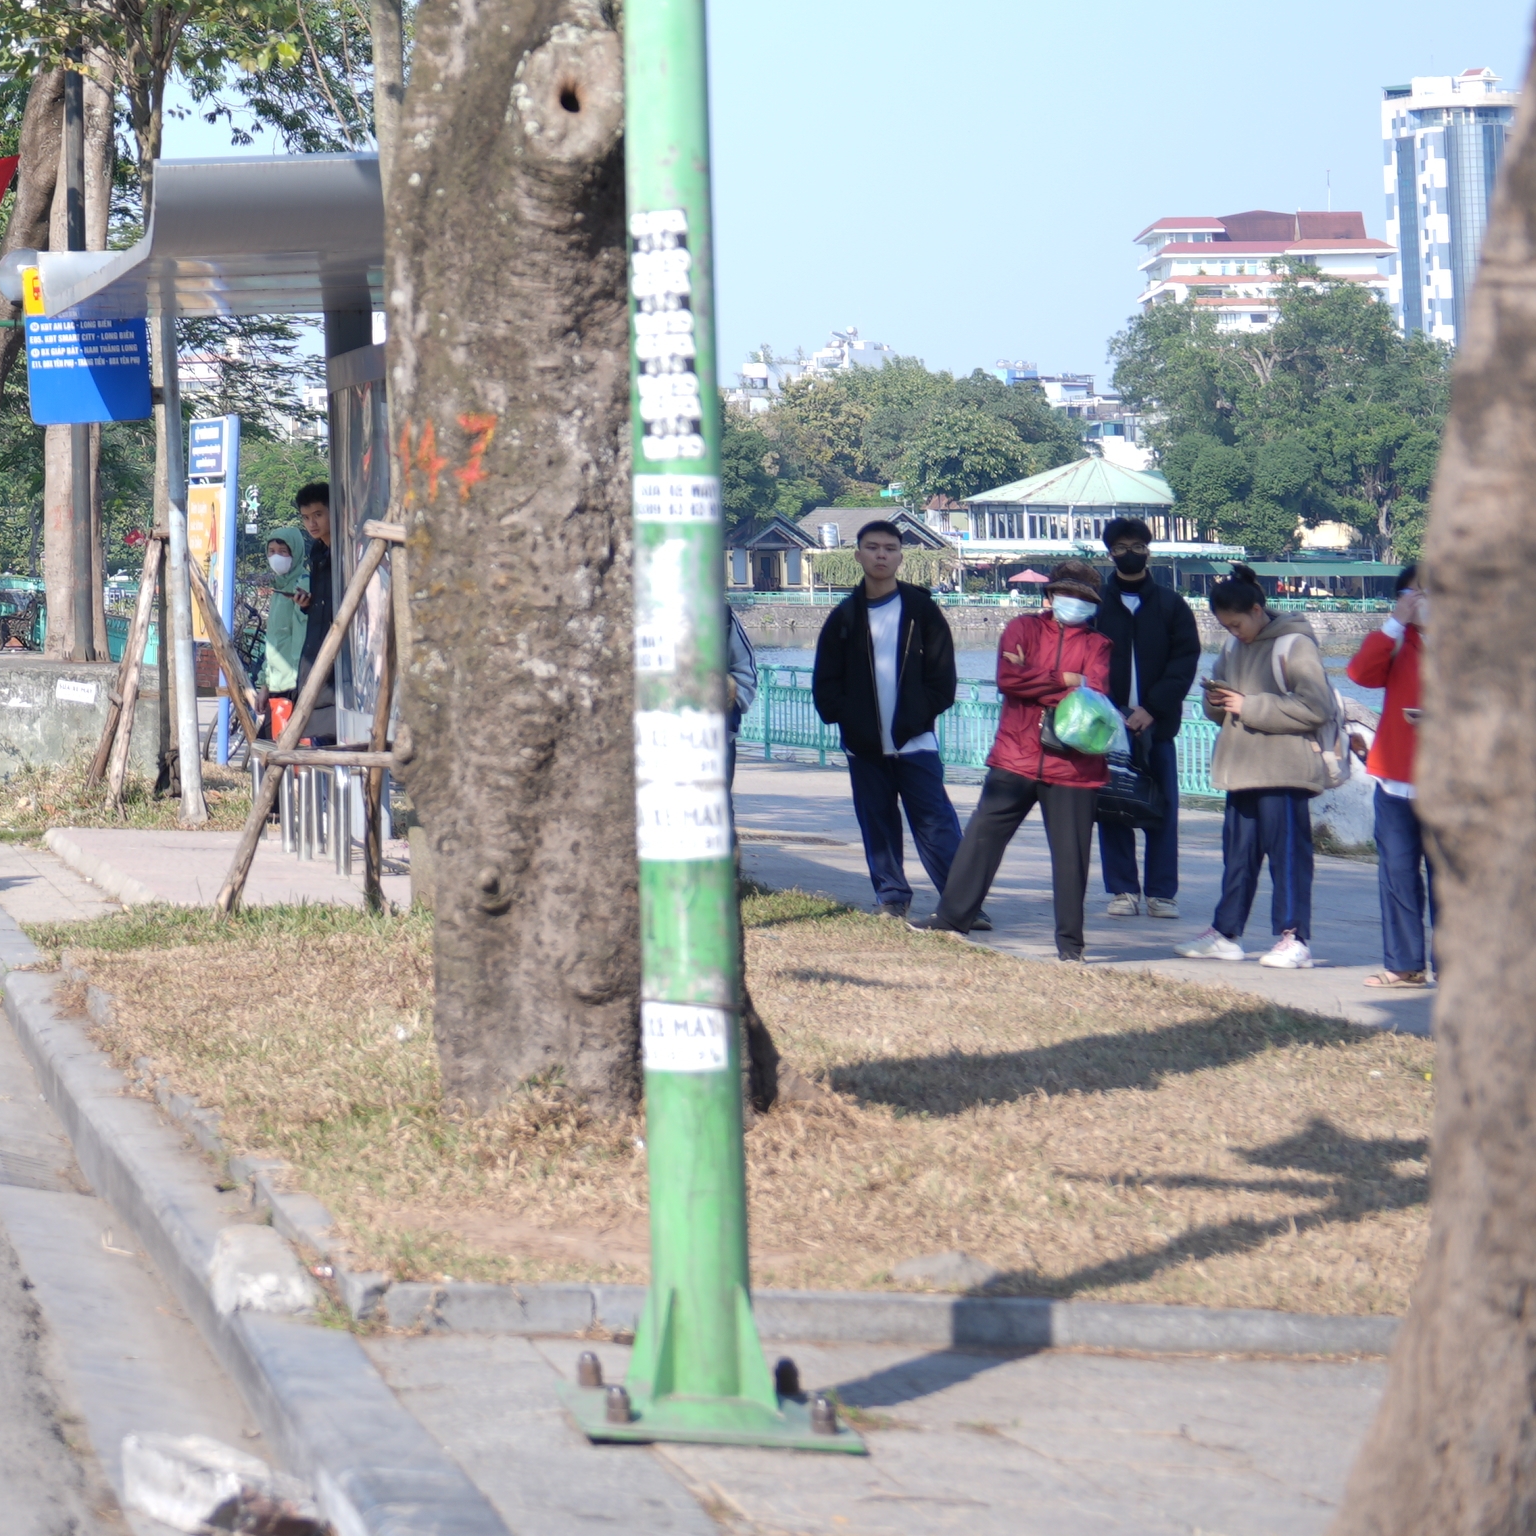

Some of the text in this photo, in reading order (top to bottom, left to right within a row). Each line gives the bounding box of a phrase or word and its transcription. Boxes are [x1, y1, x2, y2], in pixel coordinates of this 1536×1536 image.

[80, 320, 96, 329] LONG
[101, 332, 118, 340] LONG
[399, 411, 497, 508] 147
